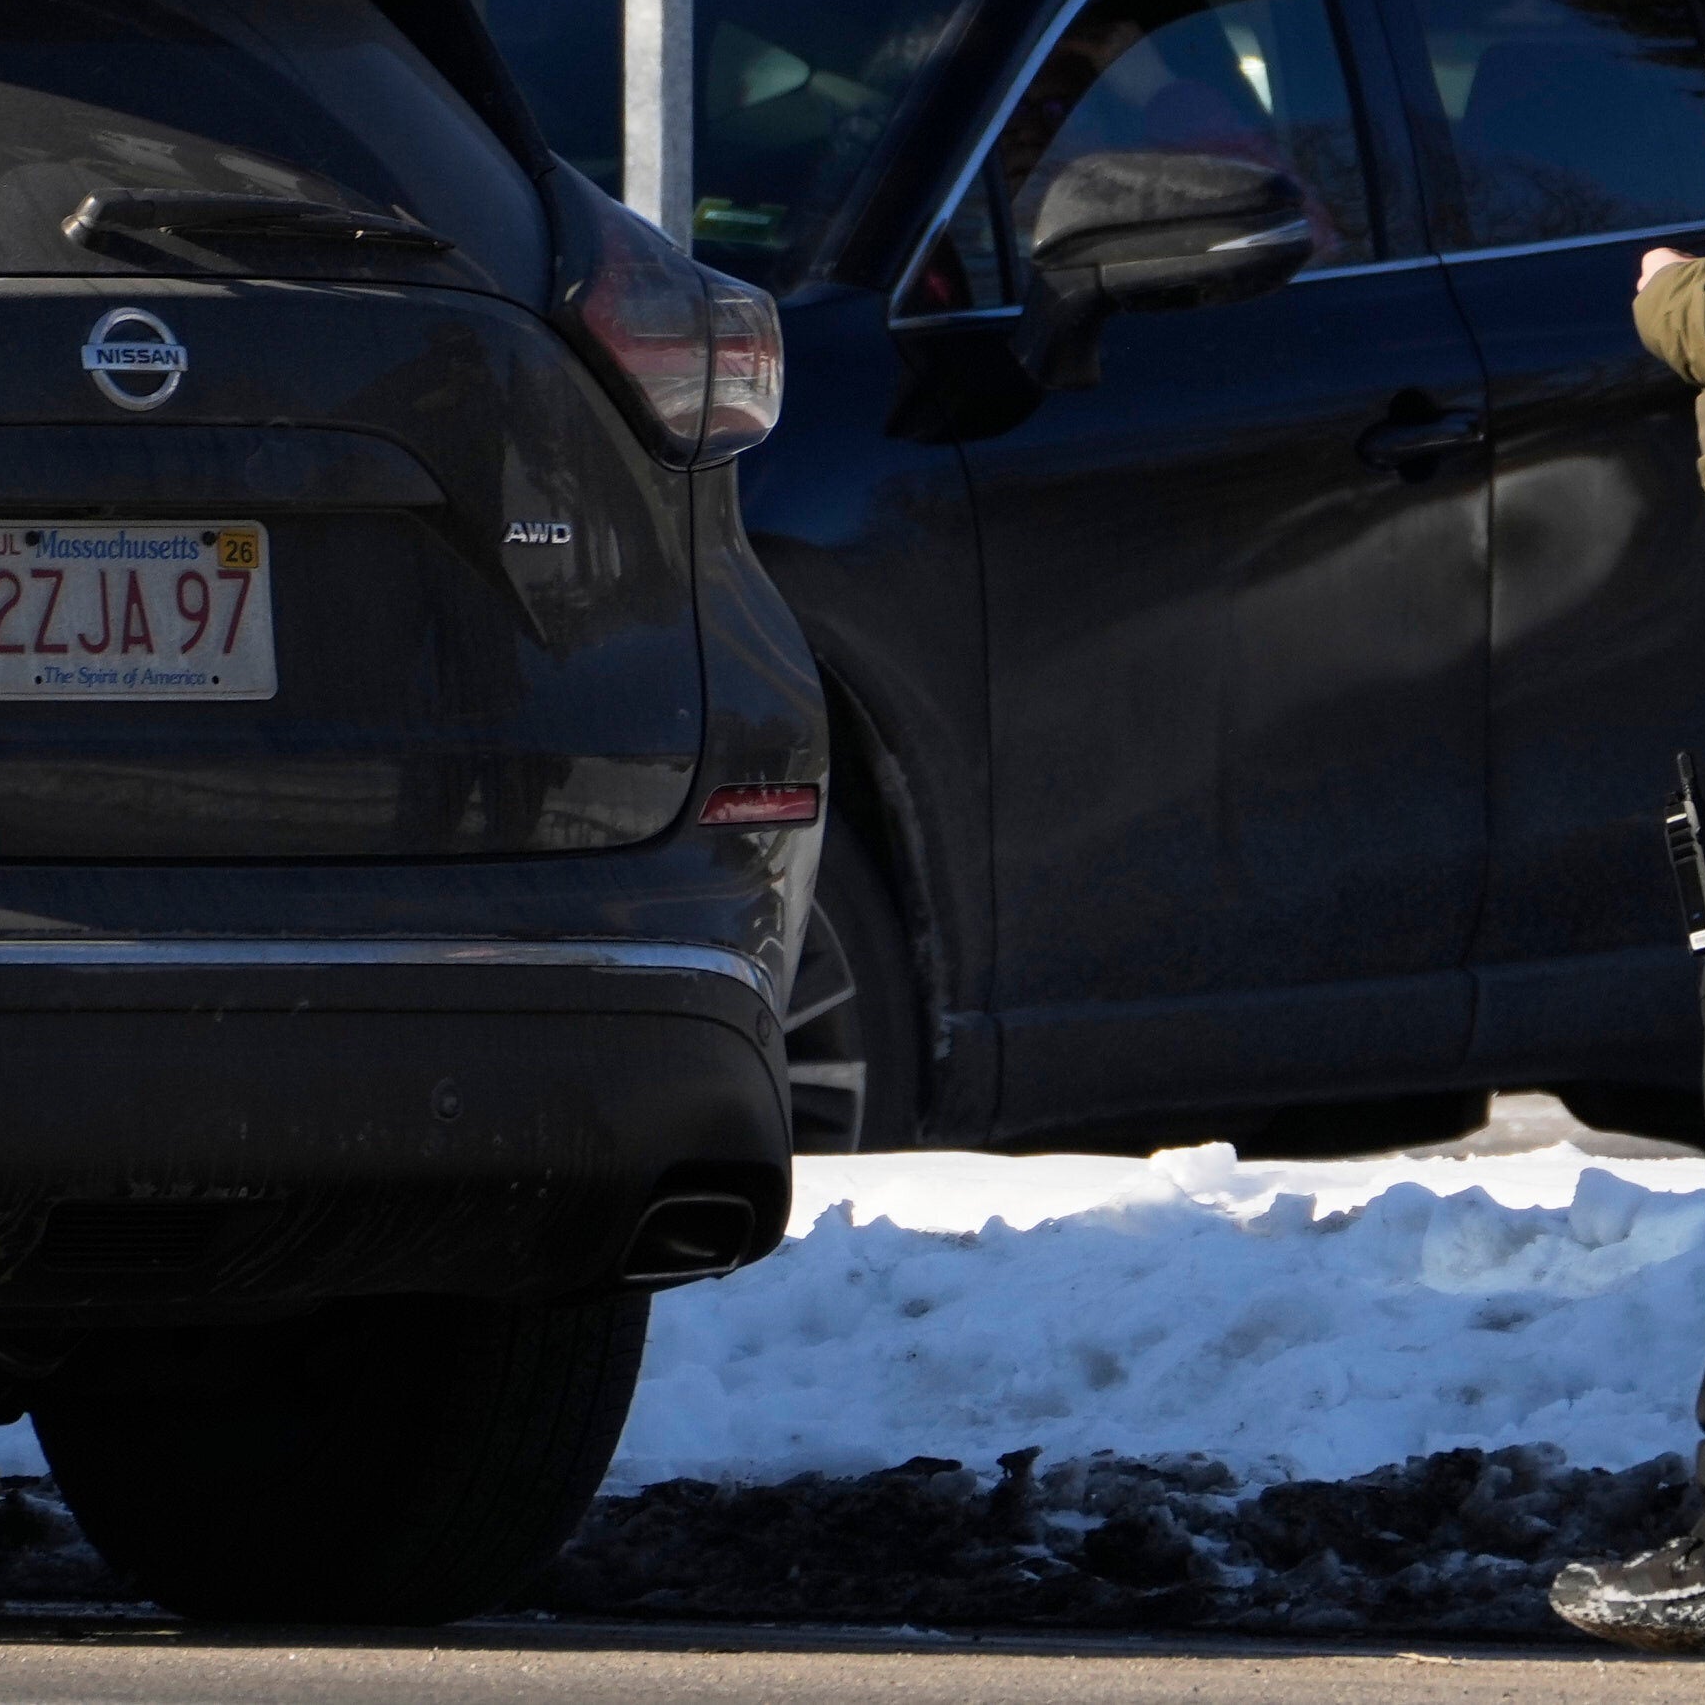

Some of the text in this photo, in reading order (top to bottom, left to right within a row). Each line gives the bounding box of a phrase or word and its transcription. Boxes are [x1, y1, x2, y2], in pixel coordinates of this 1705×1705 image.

[96, 348, 180, 366] NISSAN
[502, 521, 573, 545] AWD
[35, 528, 200, 561] Massachusetts
[225, 539, 254, 564] 26
[44, 666, 207, 688] The Spirit of America
